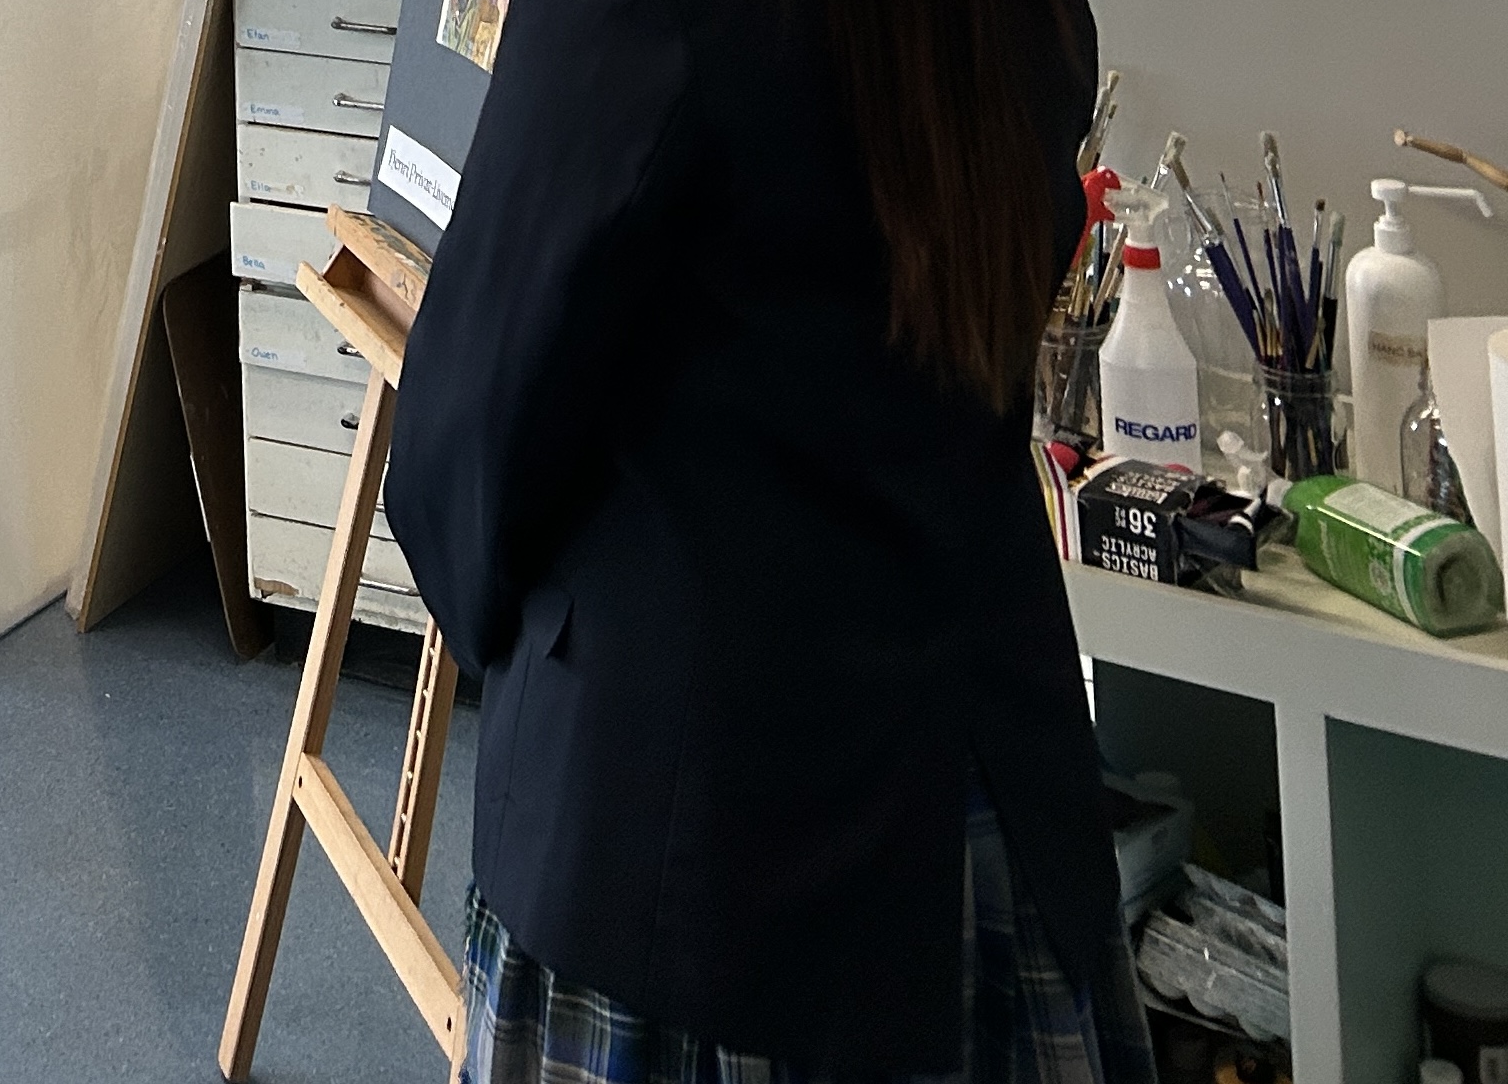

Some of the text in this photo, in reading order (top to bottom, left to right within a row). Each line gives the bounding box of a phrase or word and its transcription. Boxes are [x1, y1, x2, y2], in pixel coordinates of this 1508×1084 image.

[1115, 417, 1197, 443] REGARD
[1129, 507, 1157, 539] 36
[1101, 535, 1157, 562] ACRYLIC
[1102, 552, 1159, 582] BASICS
